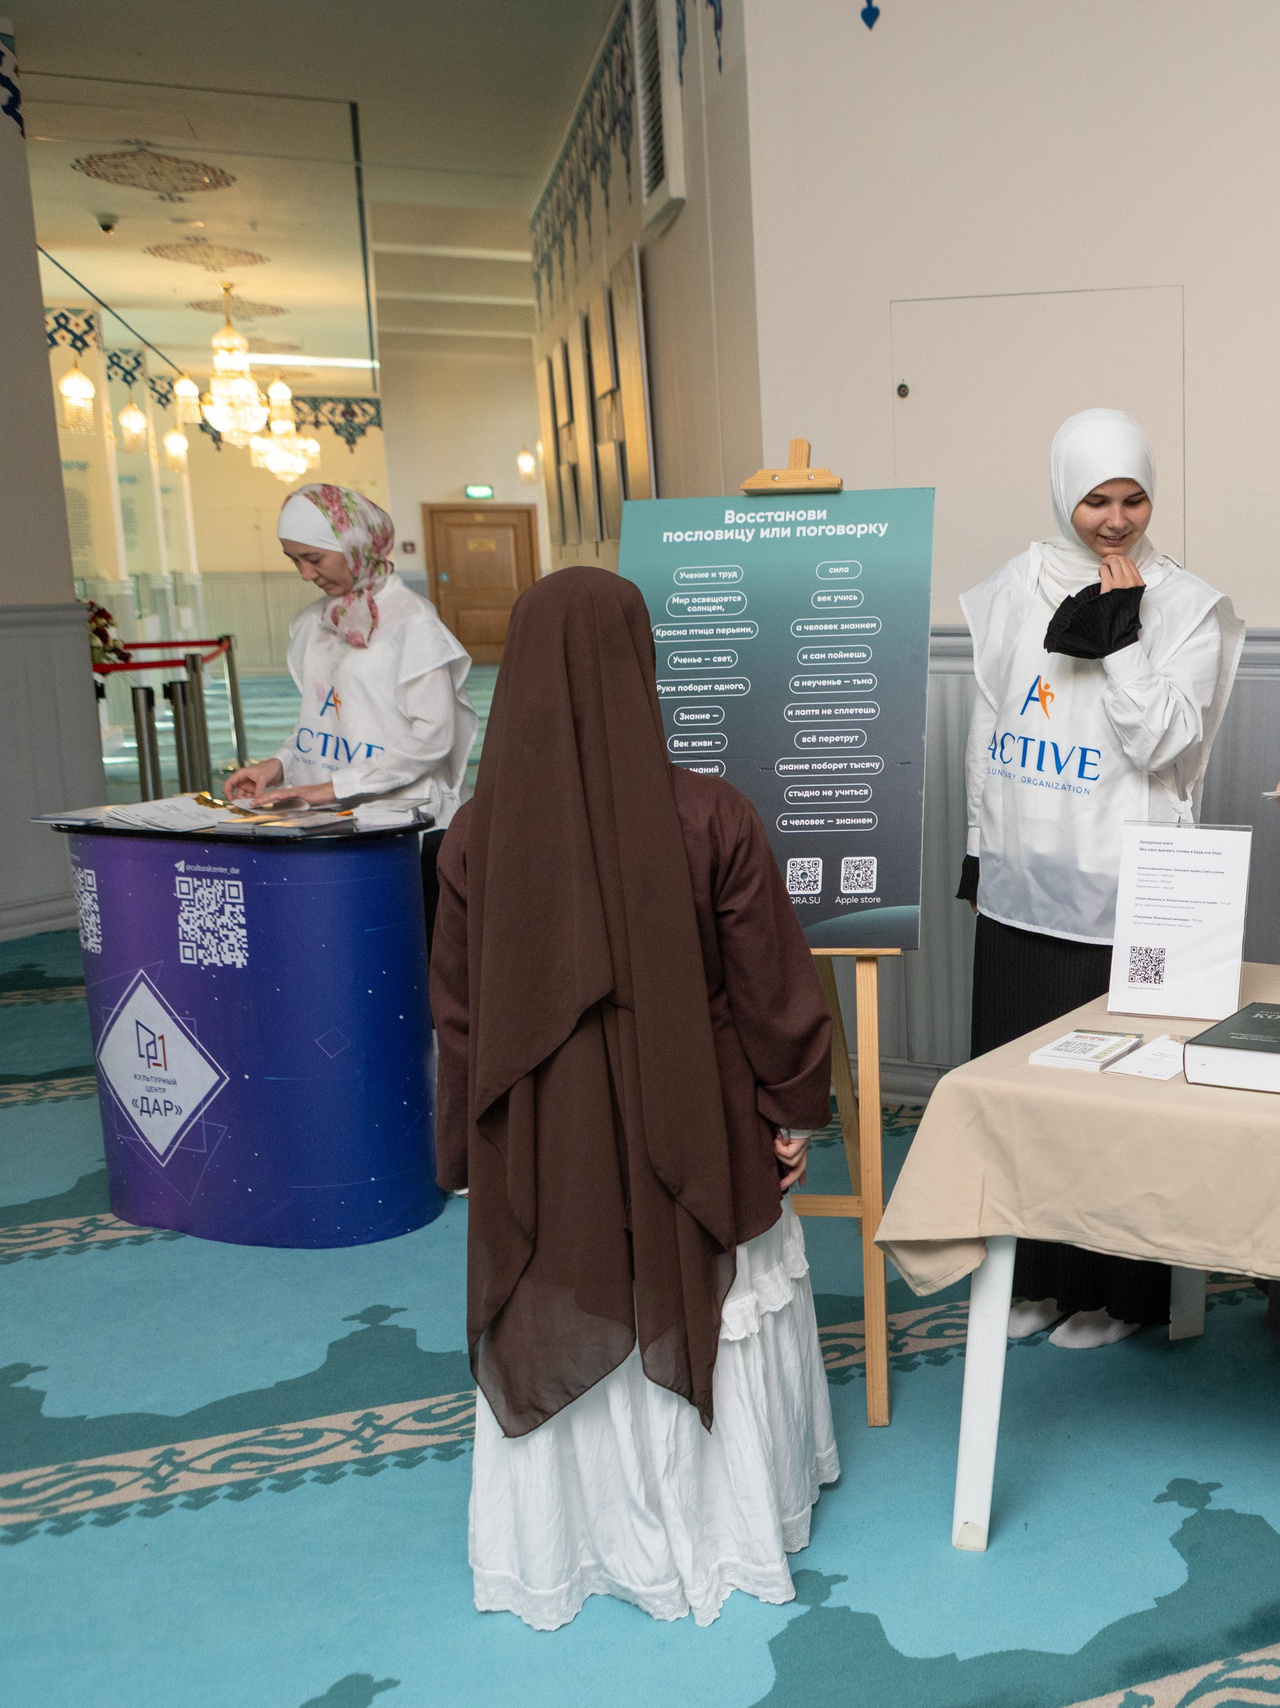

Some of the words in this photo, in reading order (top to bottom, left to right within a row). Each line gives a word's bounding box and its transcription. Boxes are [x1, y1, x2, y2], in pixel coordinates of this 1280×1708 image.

[724, 510, 827, 524] Восстанови
[663, 528, 755, 543] пословицу
[759, 526, 791, 539] или
[796, 522, 888, 538] поговорку
[679, 571, 709, 580] Учение
[718, 570, 738, 579] труд
[829, 566, 850, 574] сила
[672, 596, 690, 605] Мир
[691, 595, 742, 604] освещается
[833, 594, 858, 603] учись
[687, 604, 725, 613] солнцем,
[840, 621, 877, 630] знанием
[655, 629, 687, 638] Красна
[689, 628, 714, 636] птица
[715, 626, 754, 636] перьями,
[672, 655, 703, 664] Ученье
[712, 655, 733, 663] свет,
[827, 650, 867, 660] поймешь
[801, 679, 842, 688] неученье
[852, 677, 873, 685] тьма
[656, 684, 676, 694] Руки
[677, 683, 713, 693] поборят
[713, 682, 746, 691] одного,
[794, 707, 820, 716] лаптя
[821, 707, 832, 715] не
[833, 706, 876, 715] сплетешь
[679, 712, 711, 721] Знание
[673, 740, 689, 748] Век
[690, 739, 713, 747] живи
[801, 735, 817, 743] всё
[818, 734, 860, 744] перетрут
[987, 729, 1101, 781] ACTIVE
[778, 762, 810, 771] знание
[811, 761, 848, 770] поборет
[849, 760, 881, 769] тысячу
[1020, 775, 1091, 795] ORGANIZATION
[788, 790, 820, 798] стыдно
[821, 788, 833, 796] не
[834, 788, 869, 797] учиться
[835, 816, 873, 825] знанием
[835, 896, 859, 906] Apple
[860, 896, 882, 904] store
[133, 1073, 178, 1086] КУЛЬТУРНЫЙ
[145, 1085, 167, 1094] ЦЕНТР
[131, 1095, 183, 1118] «ДАР»
